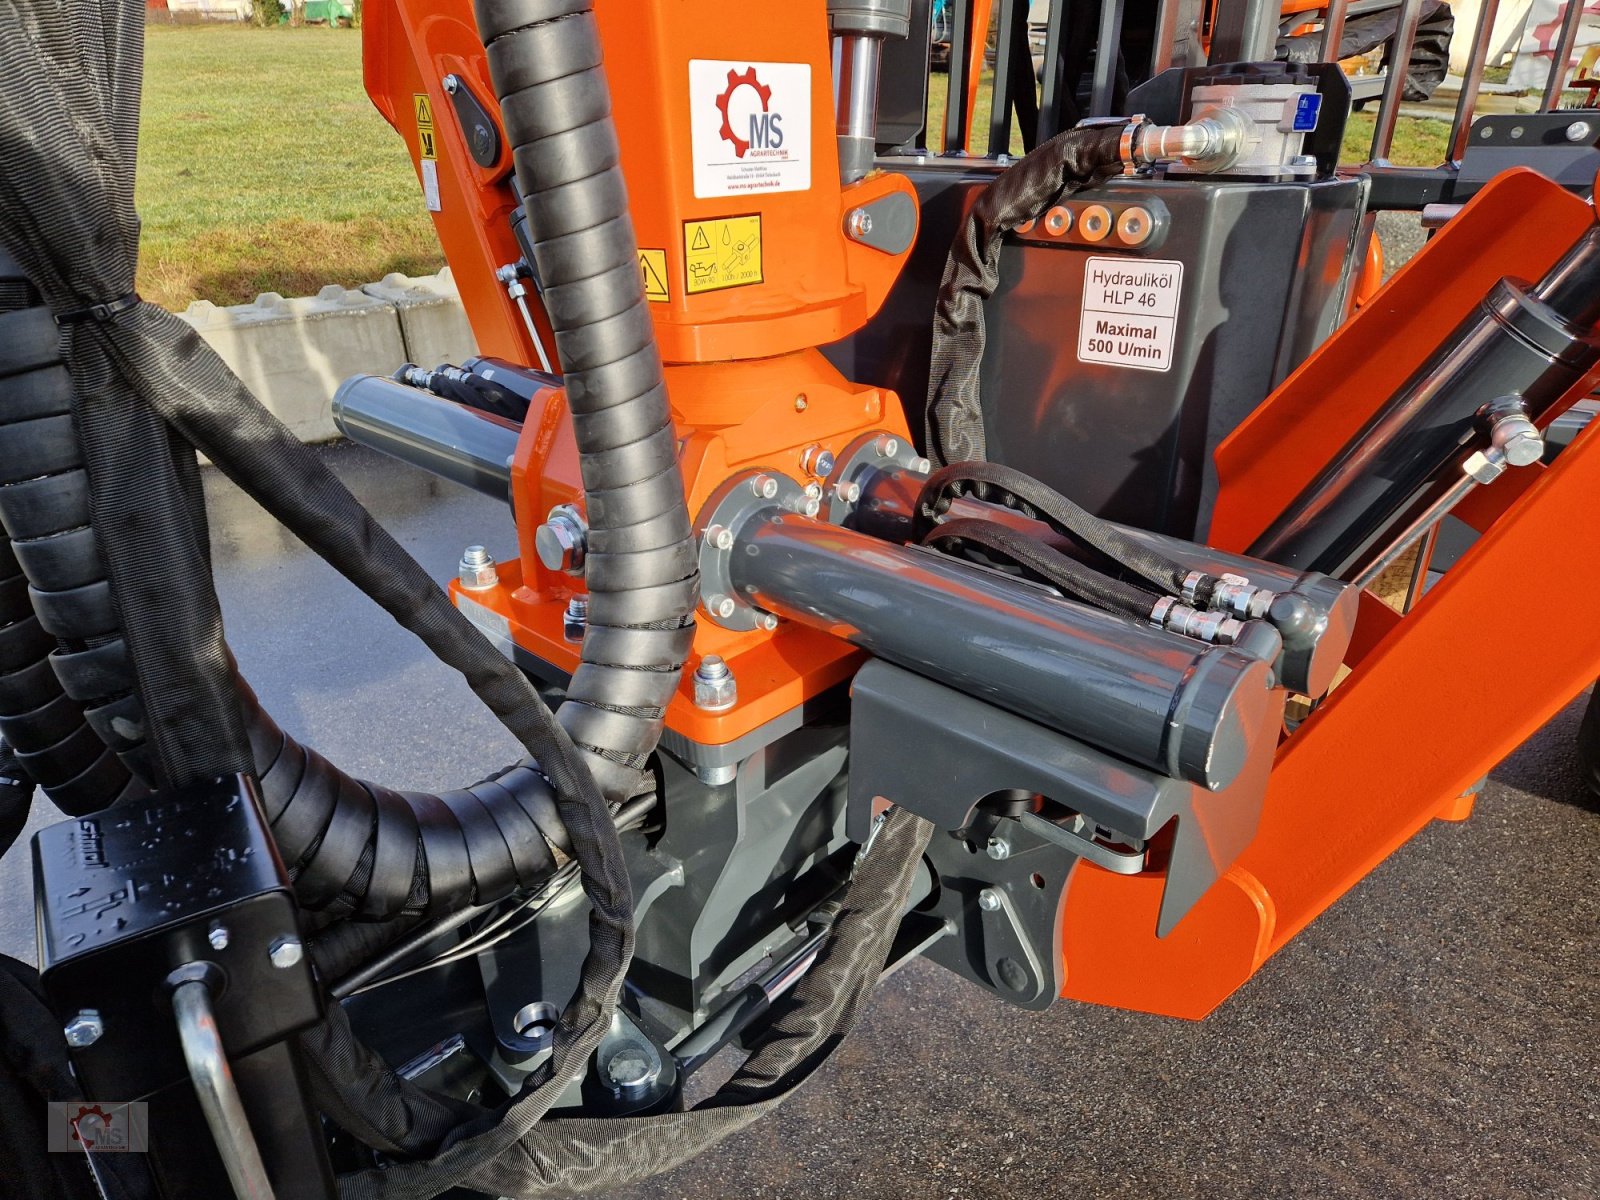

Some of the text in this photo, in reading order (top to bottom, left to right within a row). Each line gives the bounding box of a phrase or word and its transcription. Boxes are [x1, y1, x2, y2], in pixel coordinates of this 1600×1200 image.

[749, 113, 783, 149] MS
[1093, 269, 1172, 289] Hydrauliköl
[1103, 290, 1157, 307] HLP 46
[1096, 320, 1157, 340] Maximal
[1088, 338, 1162, 360] 500 U/min
